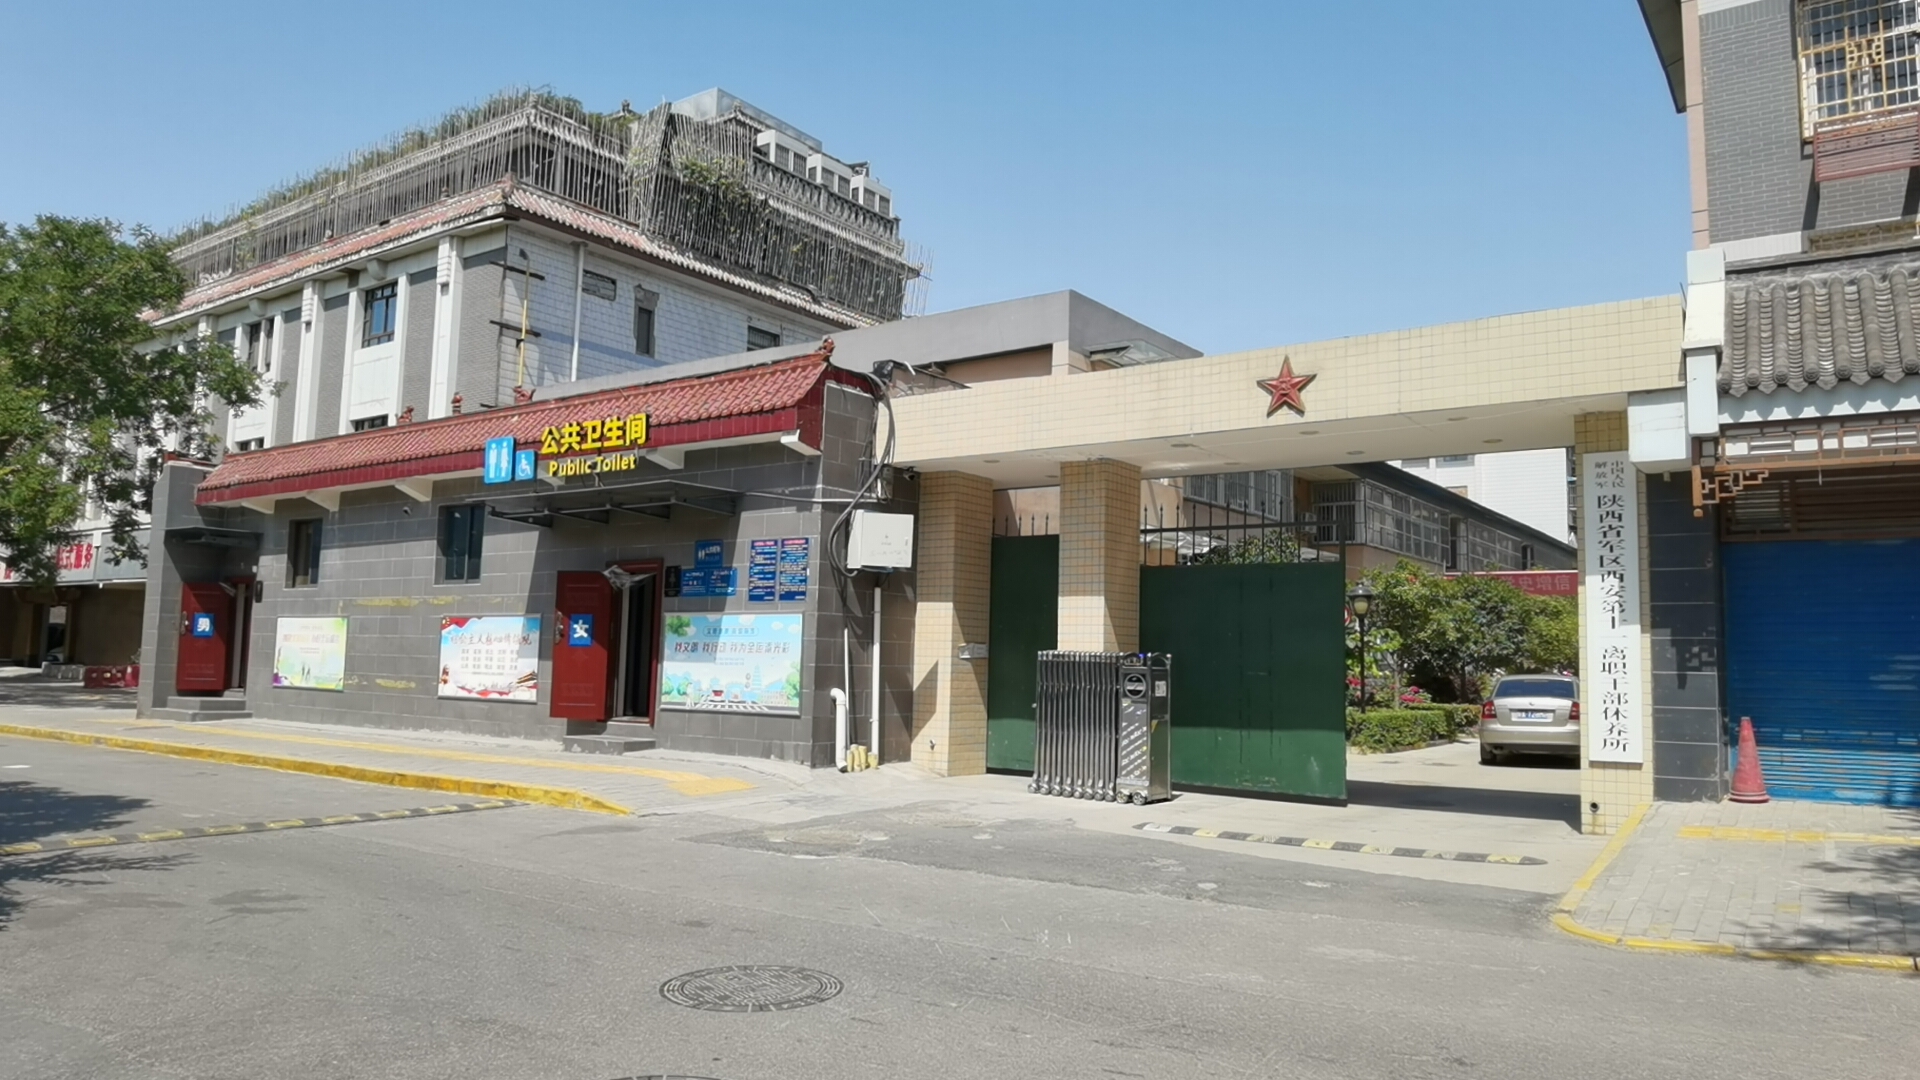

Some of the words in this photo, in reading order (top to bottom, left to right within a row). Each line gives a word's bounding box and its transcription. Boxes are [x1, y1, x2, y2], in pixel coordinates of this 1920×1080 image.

[540, 412, 649, 455] 公共卫生间
[549, 459, 592, 476] Public
[594, 454, 637, 473] Toilet
[1595, 461, 1609, 489] 解放军
[1611, 460, 1625, 488] 中国人民
[196, 617, 210, 632] 男
[573, 619, 589, 638] 女
